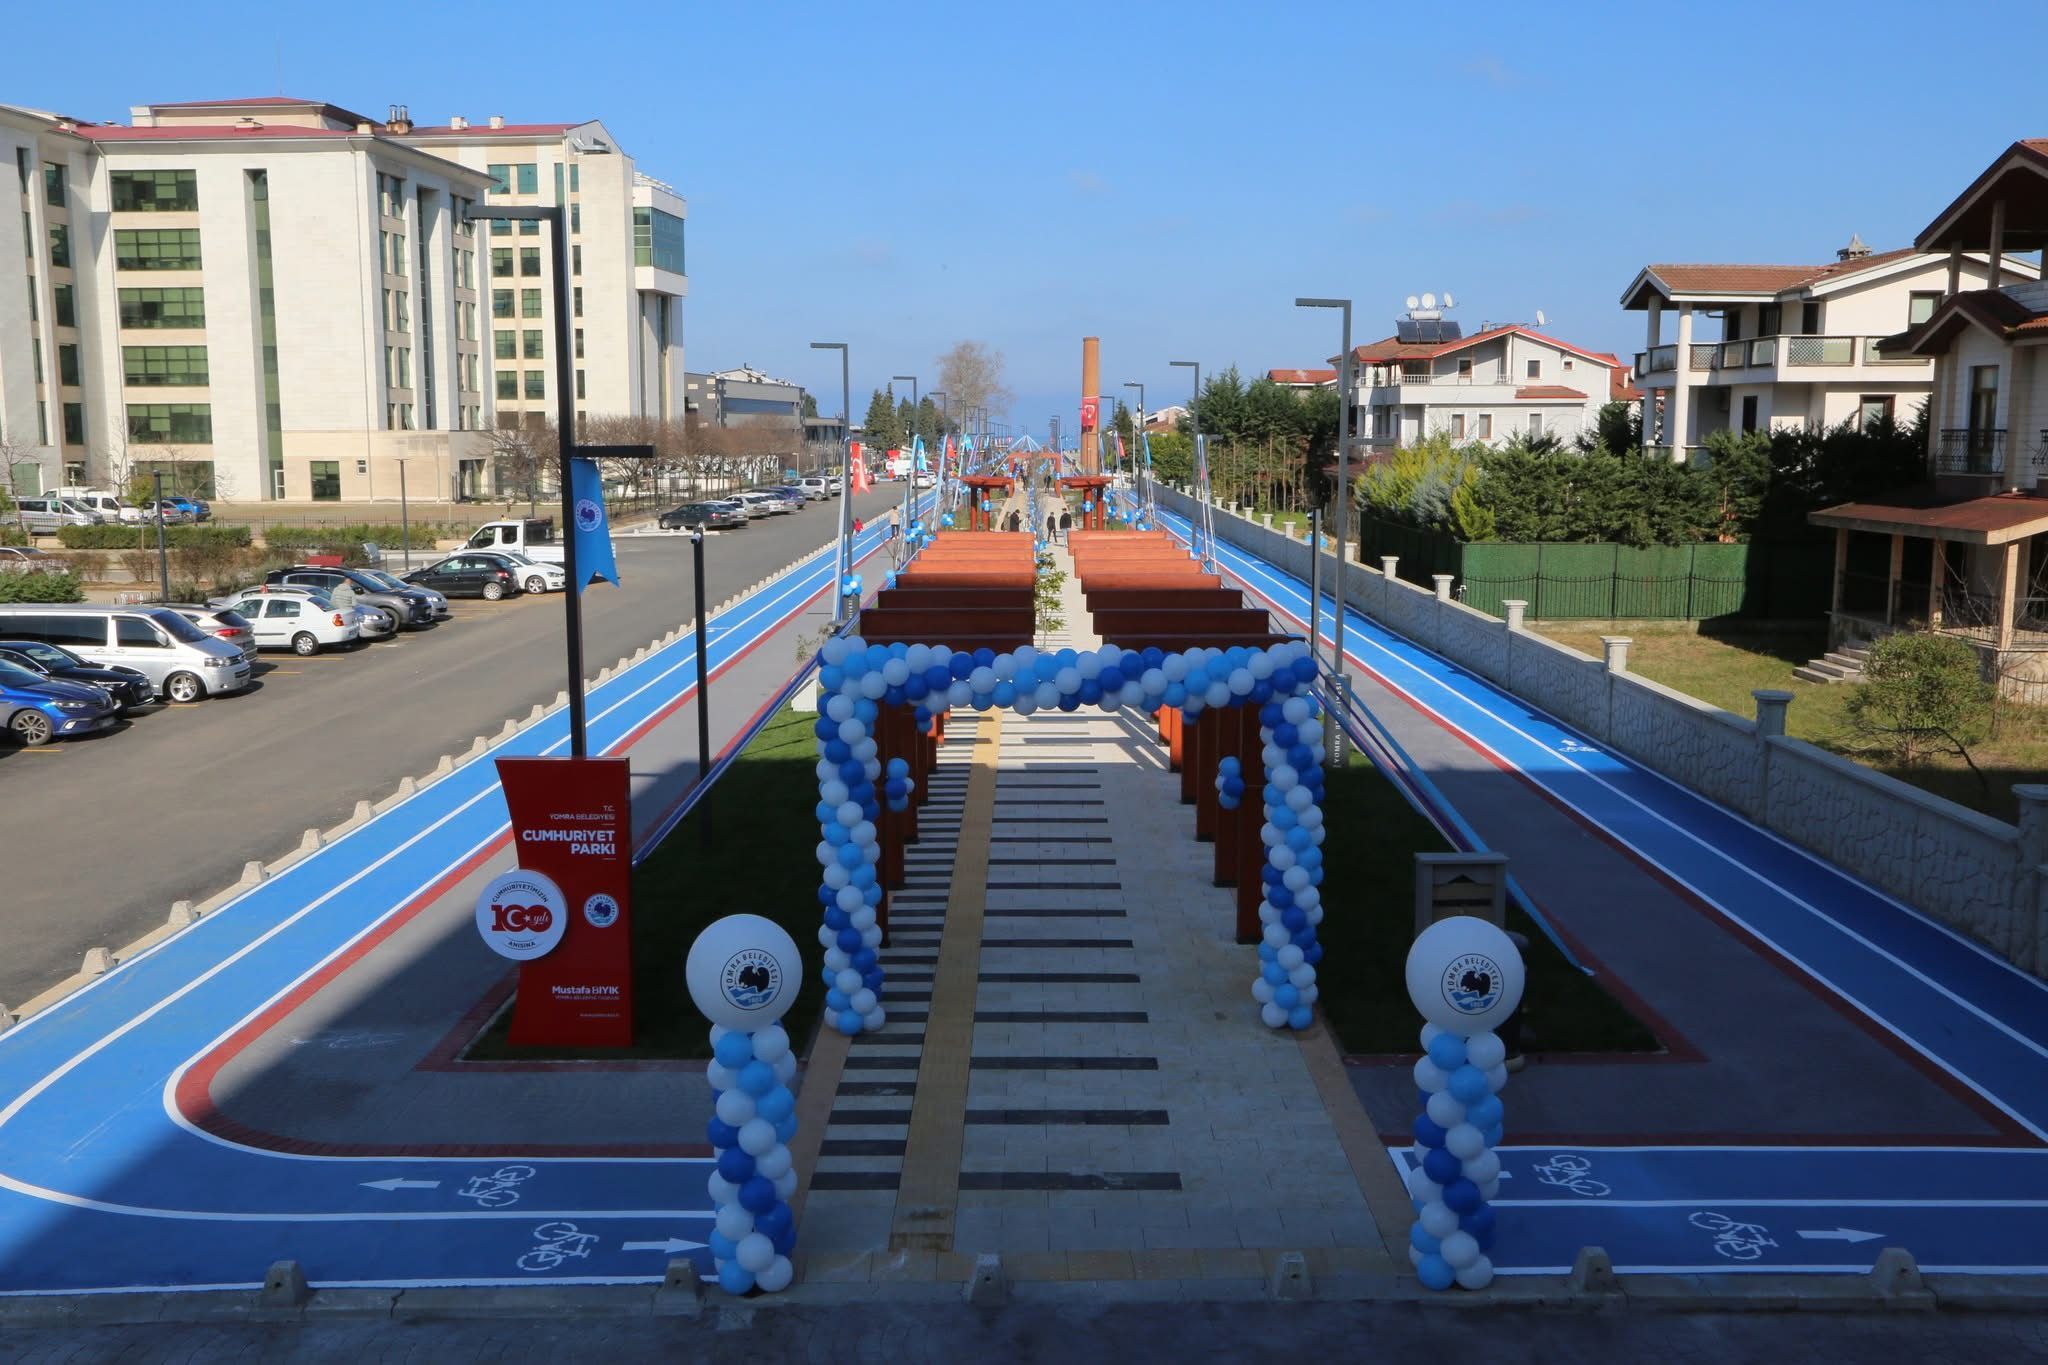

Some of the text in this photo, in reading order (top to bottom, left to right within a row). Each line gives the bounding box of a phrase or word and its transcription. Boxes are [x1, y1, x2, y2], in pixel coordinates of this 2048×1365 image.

[552, 985, 591, 994] Mustafa
[727, 959, 741, 990] YOMRA
[1447, 962, 1463, 992] YOMRA
